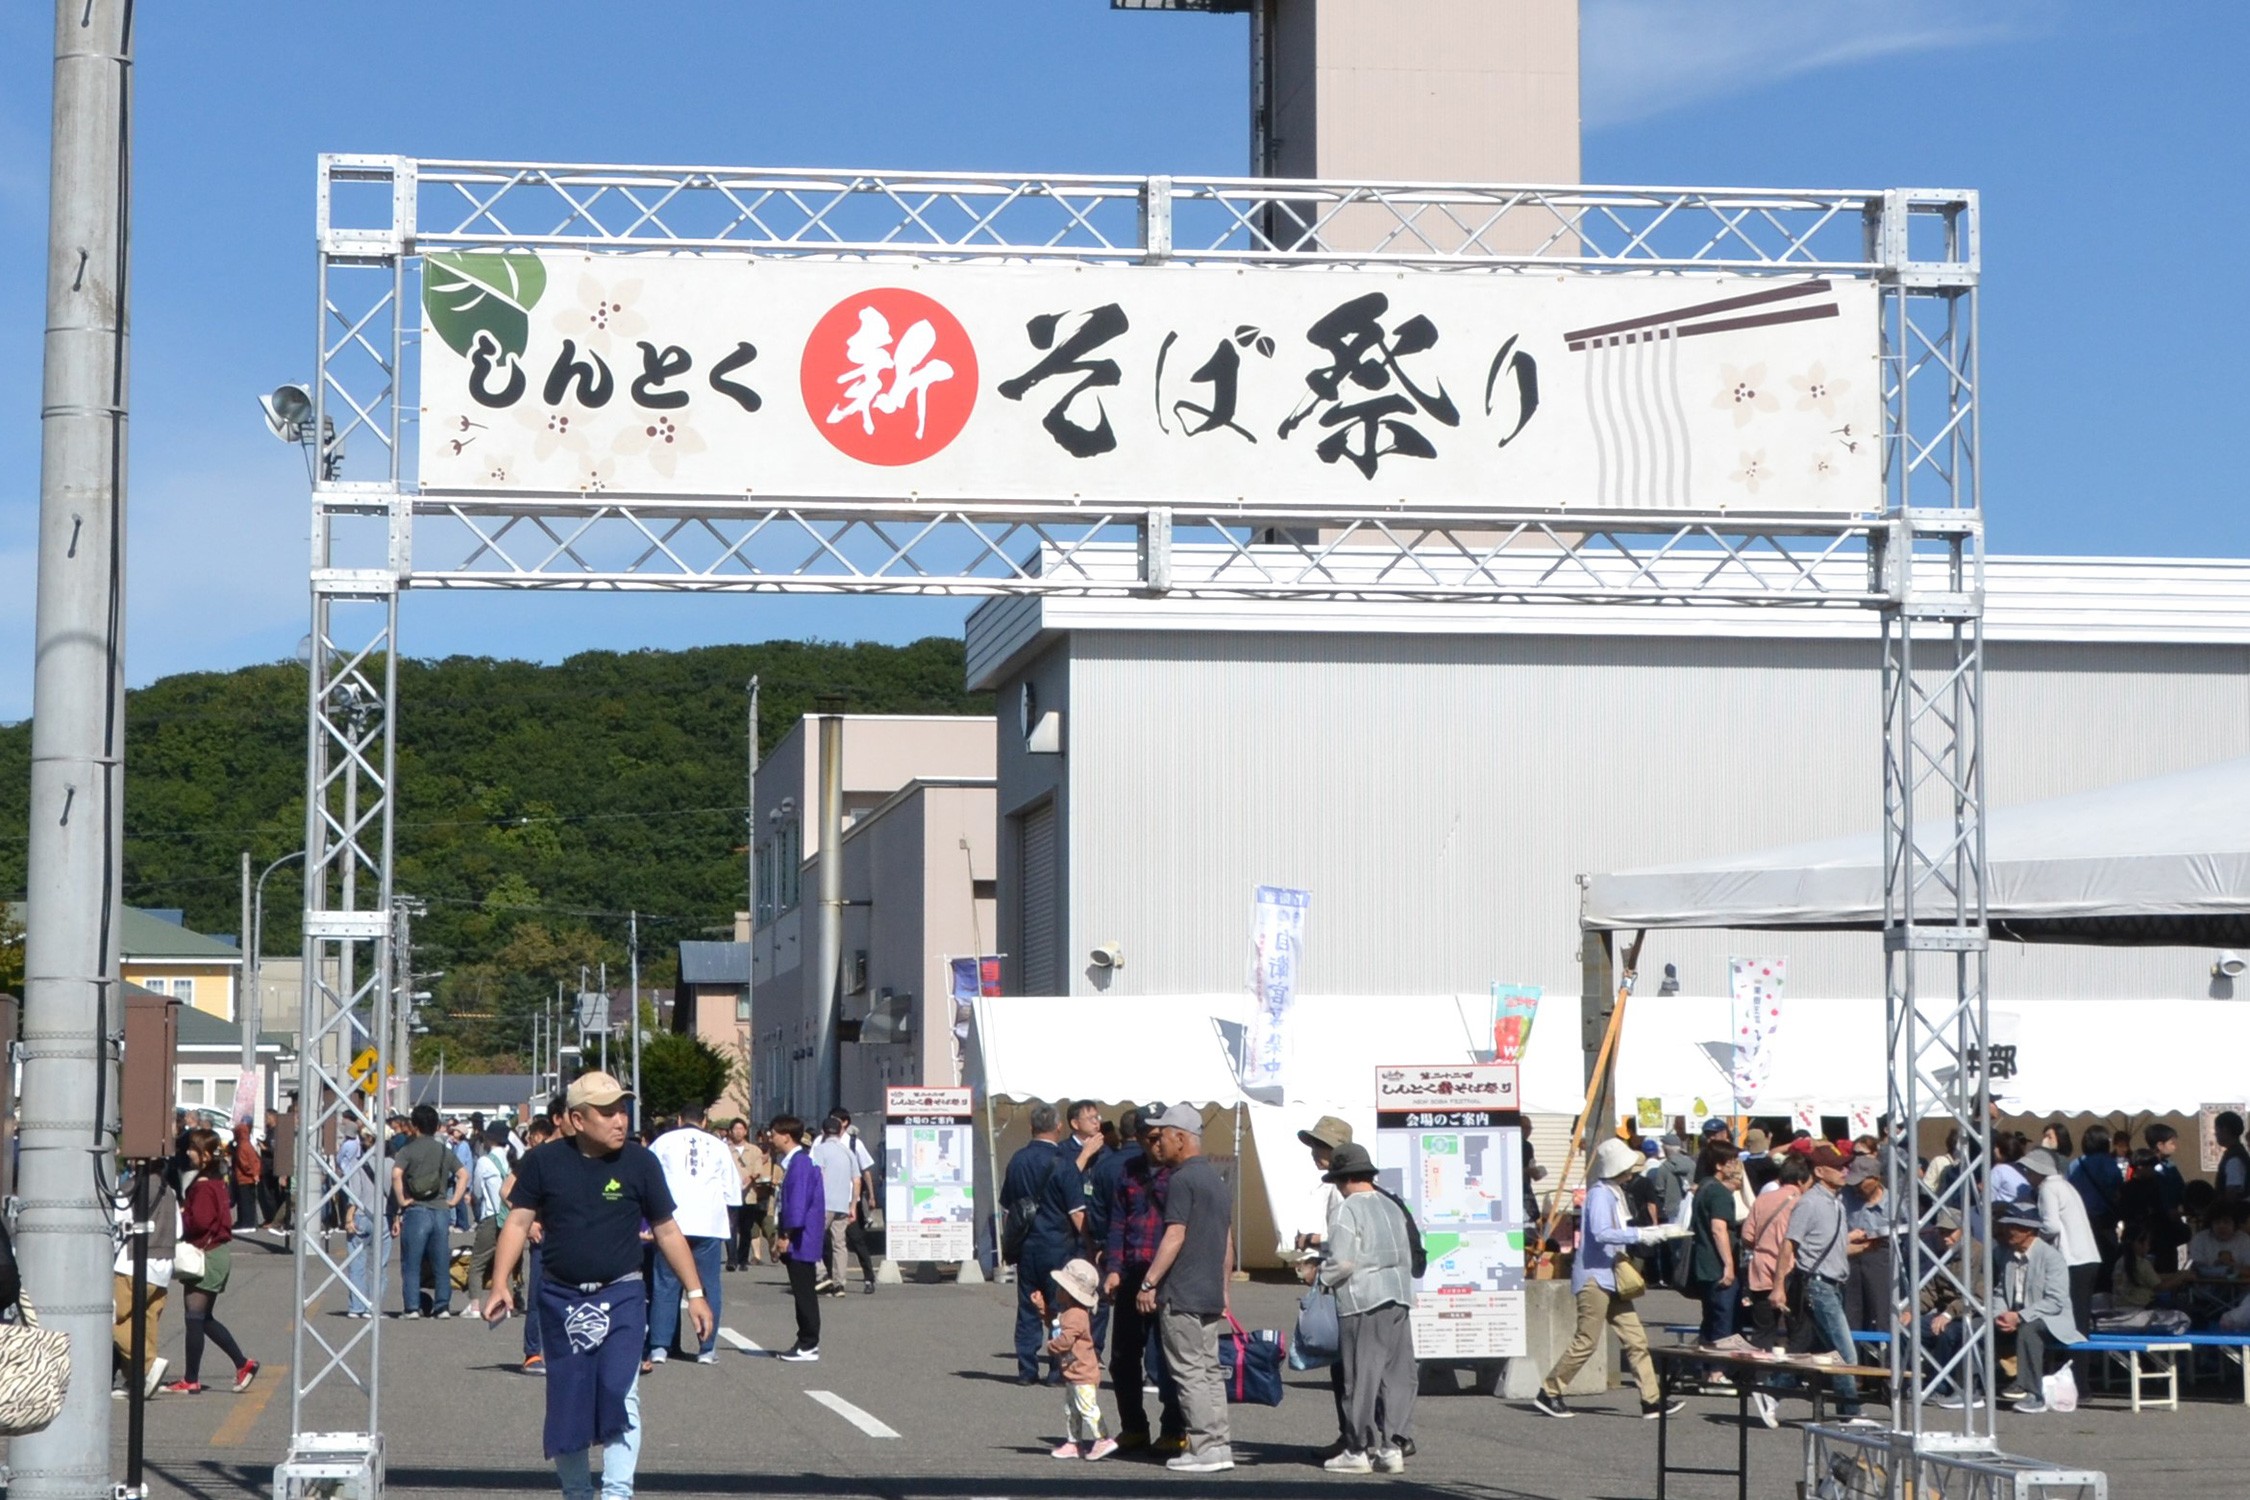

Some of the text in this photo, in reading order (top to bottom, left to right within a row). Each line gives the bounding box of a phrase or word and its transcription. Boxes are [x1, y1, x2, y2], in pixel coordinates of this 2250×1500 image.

[467, 290, 1538, 481] しんとく 新 そば祭り
[1405, 1112, 1490, 1127] 会場のご案内
